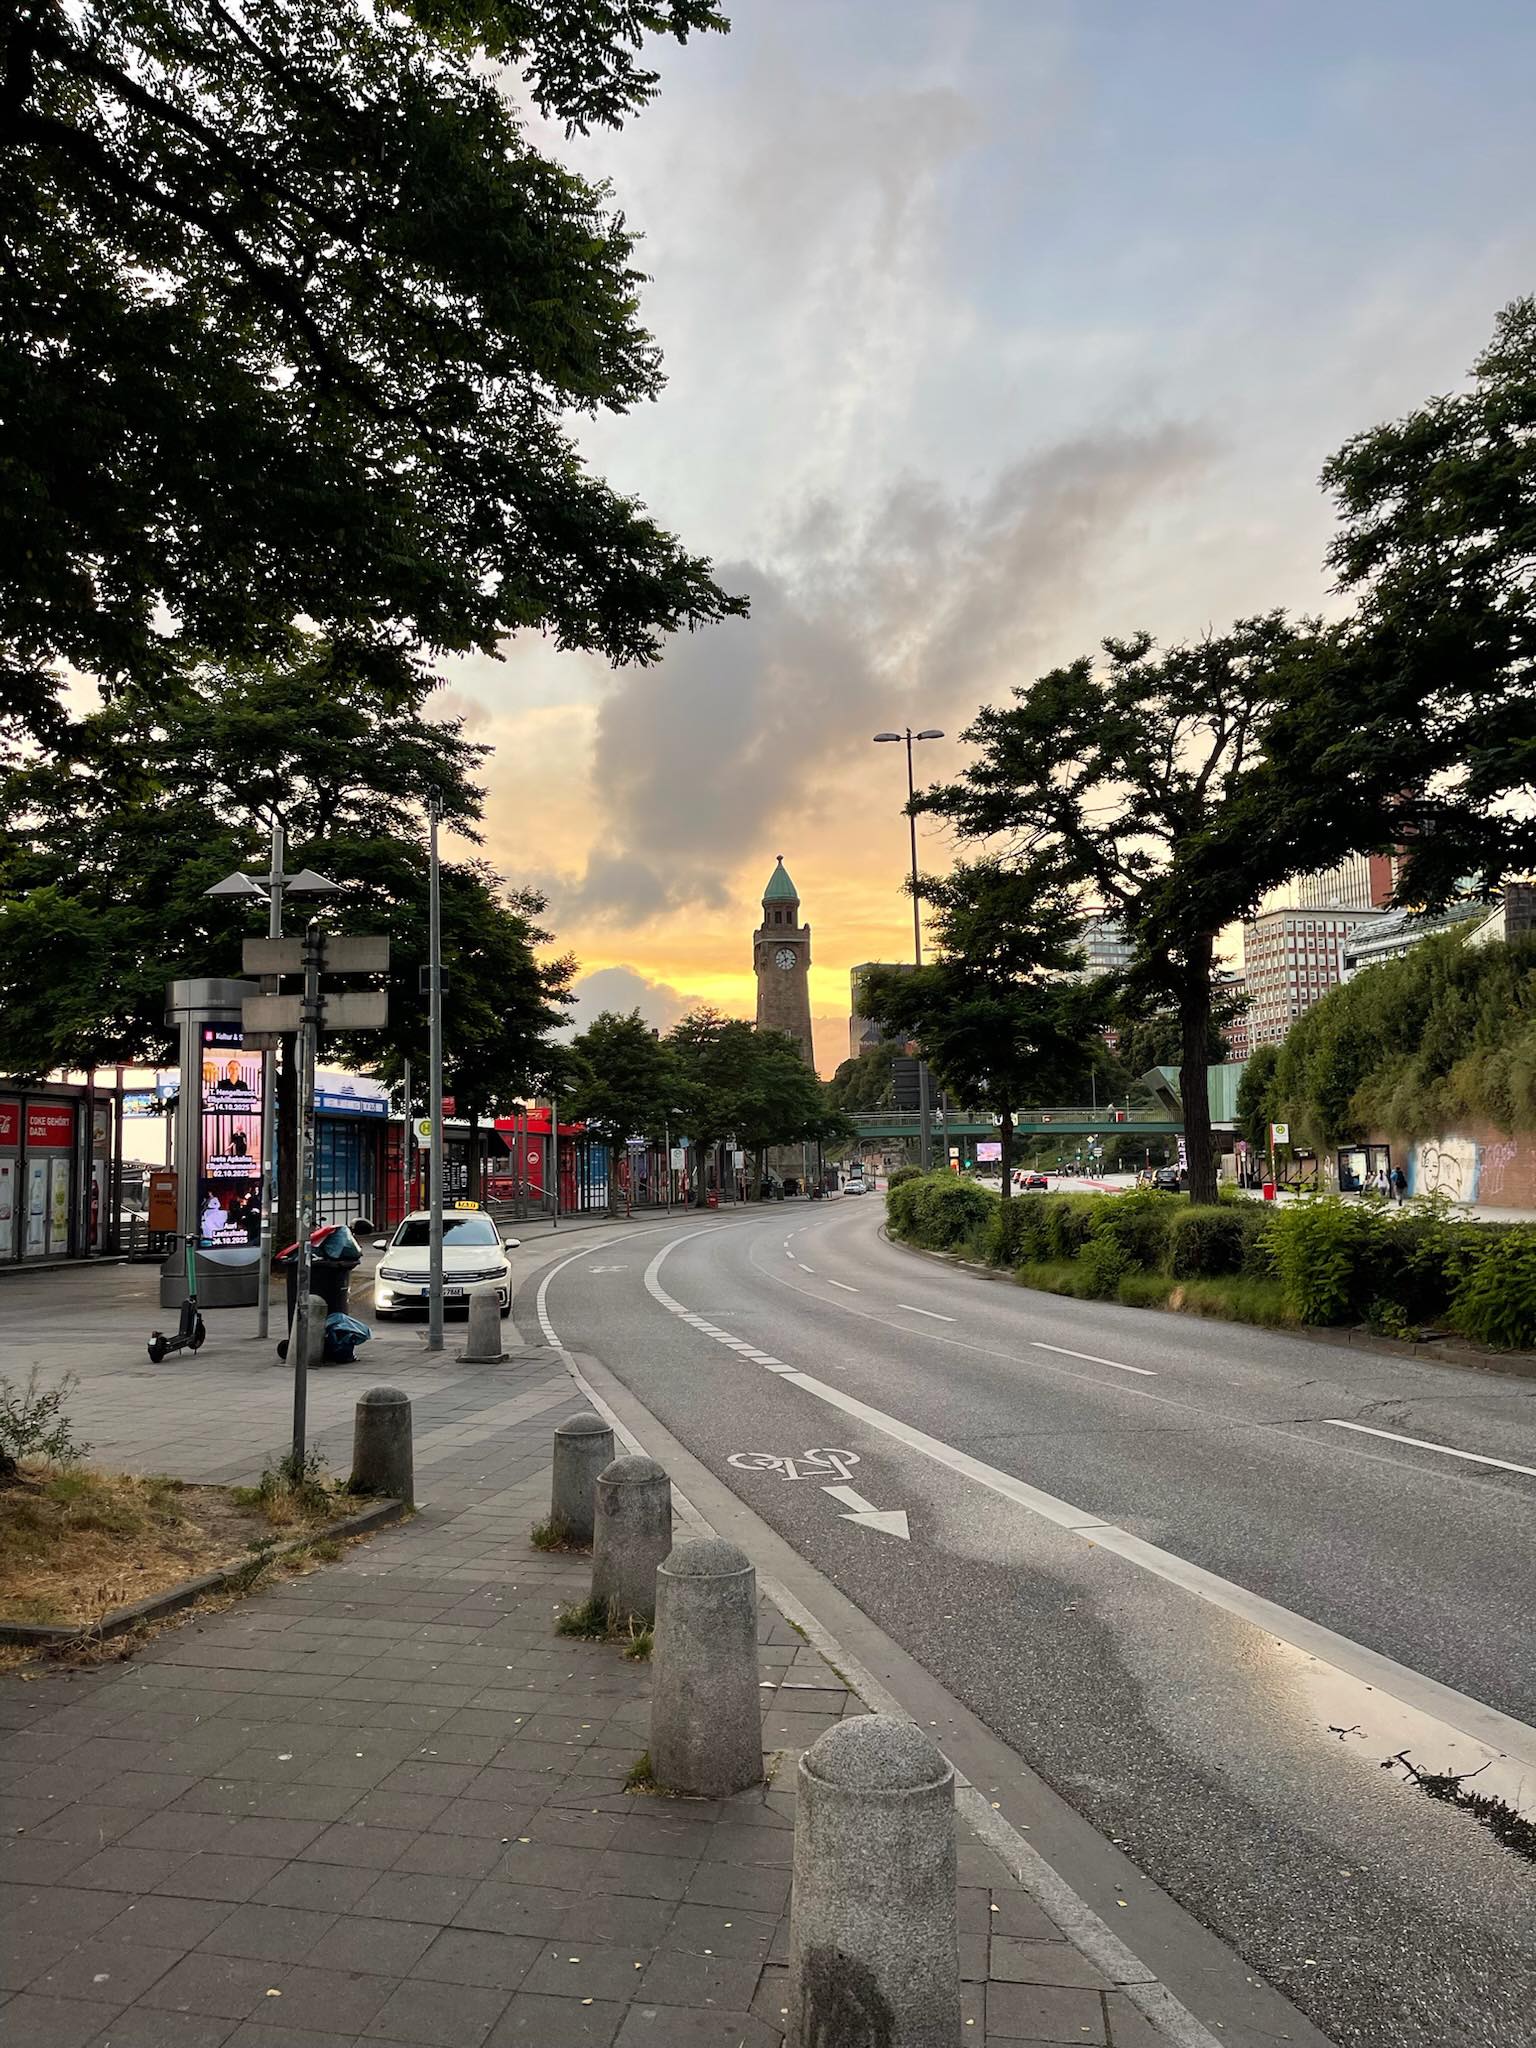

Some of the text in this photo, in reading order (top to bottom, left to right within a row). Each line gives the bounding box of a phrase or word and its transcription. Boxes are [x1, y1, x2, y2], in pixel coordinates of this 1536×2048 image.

[207, 1096, 257, 1104] Elbphilharmonie
[30, 1115, 70, 1126] COKE GEHÖRT
[30, 1127, 47, 1136] DAZU.
